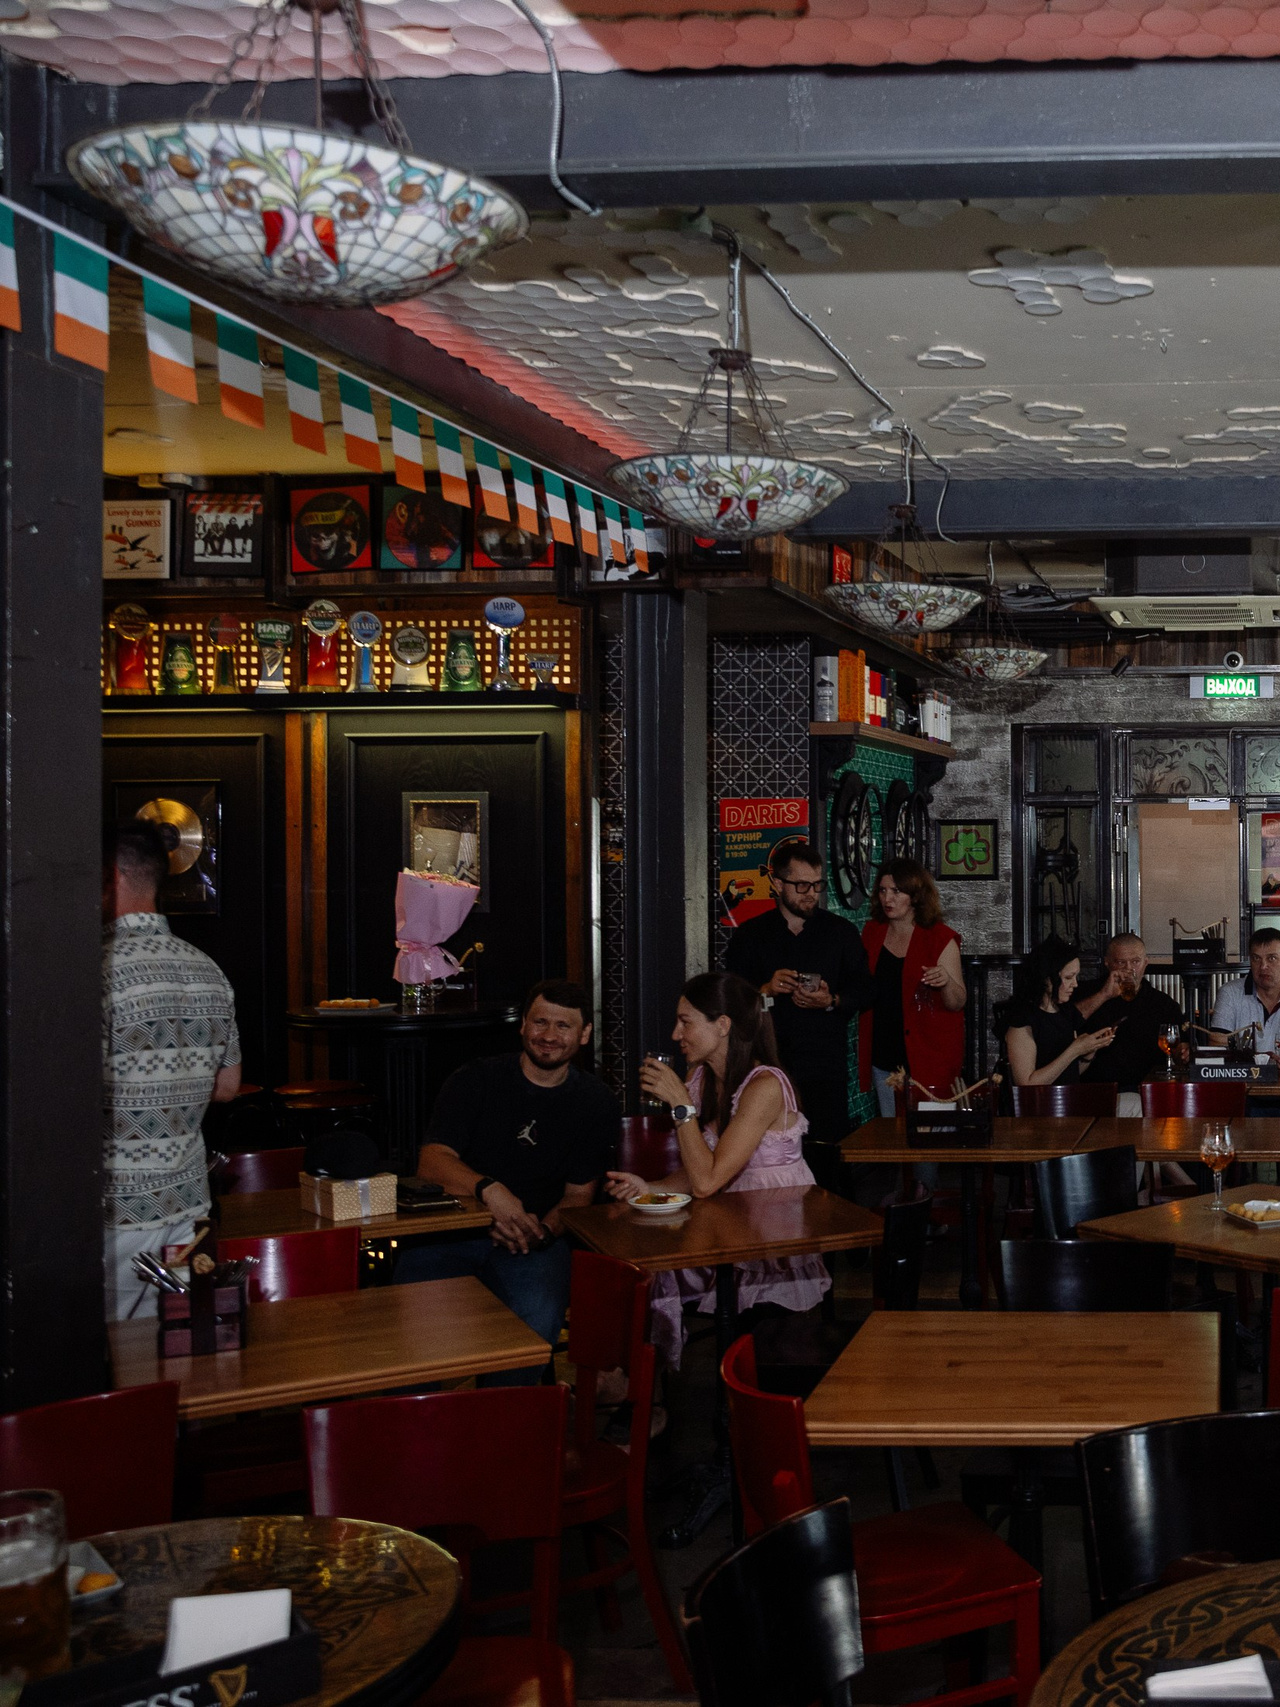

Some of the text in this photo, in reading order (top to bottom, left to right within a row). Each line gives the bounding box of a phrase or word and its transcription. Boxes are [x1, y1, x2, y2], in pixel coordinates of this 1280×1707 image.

[107, 509, 130, 519] Lovely
[131, 509, 144, 518] day
[126, 519, 162, 528] GUINNESS
[493, 601, 517, 611] HARP
[258, 622, 291, 635] HARP
[353, 621, 379, 631] HARP
[535, 661, 554, 669] HARP
[1206, 678, 1256, 696] ВЫХОД
[725, 802, 800, 828] DARTS
[725, 832, 762, 843] ТУРНИР
[1200, 1066, 1248, 1078] GUINNESS
